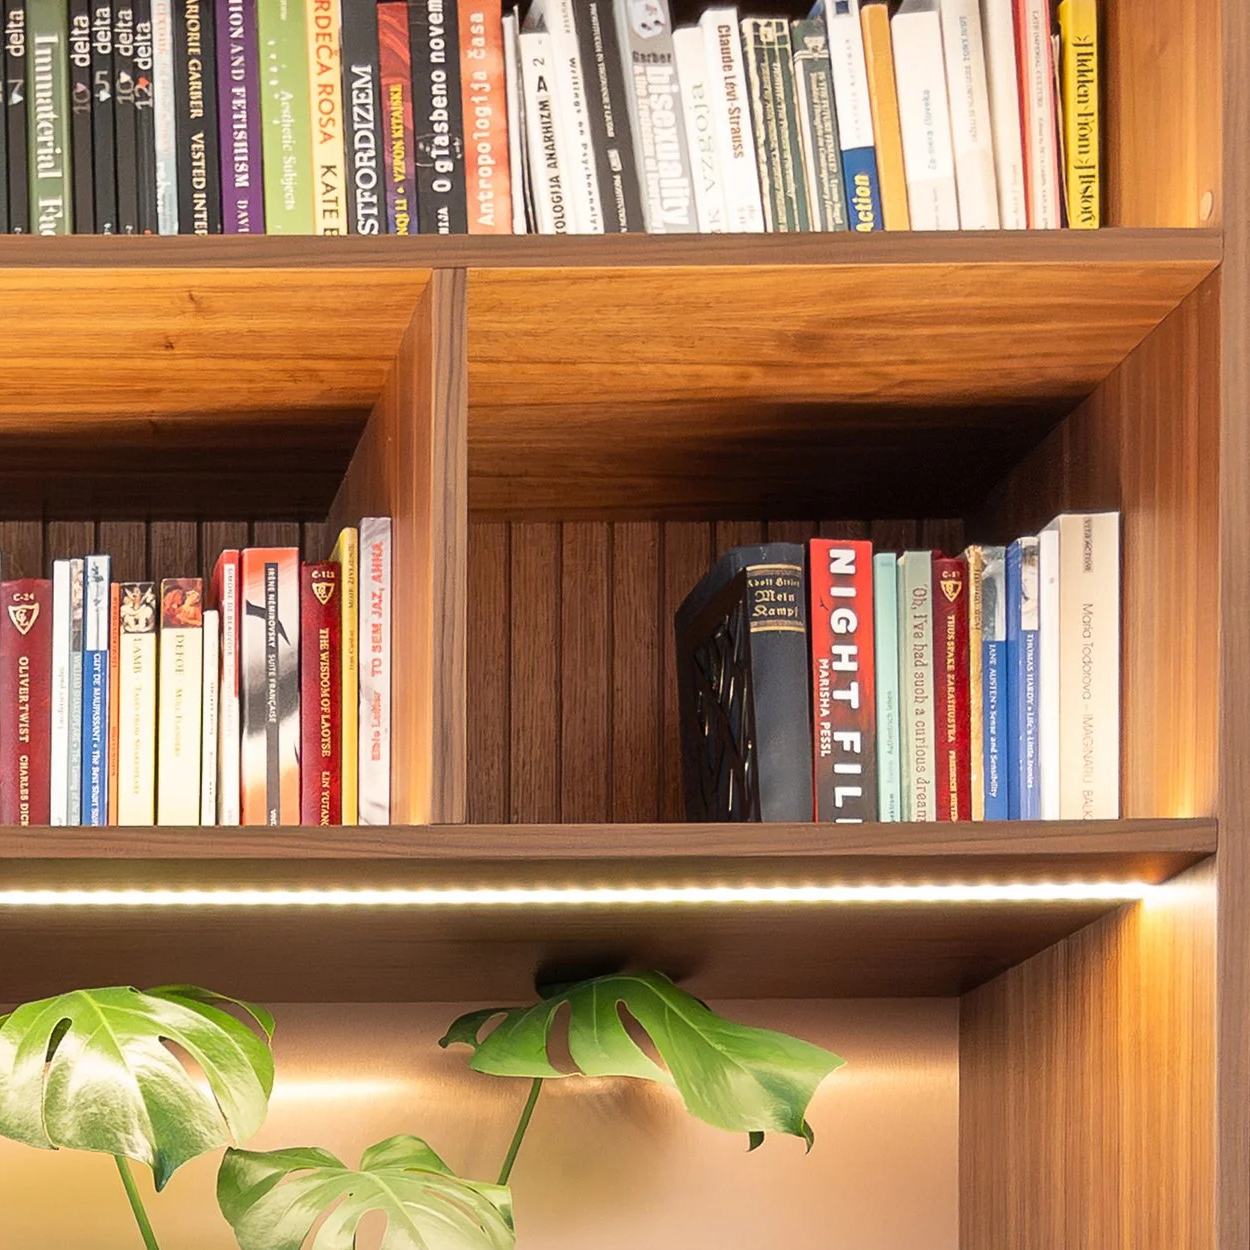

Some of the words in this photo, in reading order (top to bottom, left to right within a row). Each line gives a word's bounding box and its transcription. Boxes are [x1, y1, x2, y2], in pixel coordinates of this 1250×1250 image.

[5, 9, 24, 57] delta
[70, 15, 91, 67] delta
[92, 7, 112, 54] delta
[114, 9, 134, 56] delta
[133, 21, 153, 70] delta
[467, 11, 486, 60] časa
[716, 24, 733, 73] Claude
[229, 43, 245, 81] AND
[1071, 36, 1095, 104] Hidden
[34, 32, 63, 178] Immaterial
[188, 58, 203, 119] GARBER
[231, 86, 249, 188] FETISHISM
[278, 90, 296, 151] Aesthetic
[318, 83, 336, 145] ROSA
[428, 71, 454, 173] glasbeno
[537, 99, 558, 169] ANARHIZM
[190, 133, 207, 190] VESTED
[351, 65, 379, 235] STFORDIZEM
[471, 71, 496, 226] Antropologija
[644, 66, 691, 226] bisexuality
[281, 155, 299, 211] Subjects
[321, 164, 340, 221] KATE
[370, 541, 384, 583] ANNA
[319, 628, 330, 651] THE
[829, 548, 859, 710] NIGHT
[913, 614, 929, 639] I've
[947, 614, 956, 639] THUS
[1081, 603, 1095, 639] Maria
[267, 653, 277, 676] SUITE
[319, 652, 331, 697] WISDOM
[913, 643, 929, 667] had
[947, 640, 956, 671] SPAKE
[988, 643, 999, 665] JANE
[1025, 633, 1035, 672] THOMAS
[1081, 642, 1095, 700] Todorova
[18, 656, 29, 701] OLIVER
[818, 658, 831, 718] MARISHA
[914, 672, 929, 704] such
[988, 668, 999, 704] AUSTEN
[1025, 672, 1035, 704] HARDY
[18, 702, 29, 742] TWIST
[91, 689, 101, 742] MAUPASSANT
[320, 697, 331, 713] OF
[915, 707, 924, 716] a
[820, 721, 832, 758] PESSL
[915, 720, 929, 773] curious
[988, 736, 998, 753] and
[19, 755, 29, 801] CHARLES
